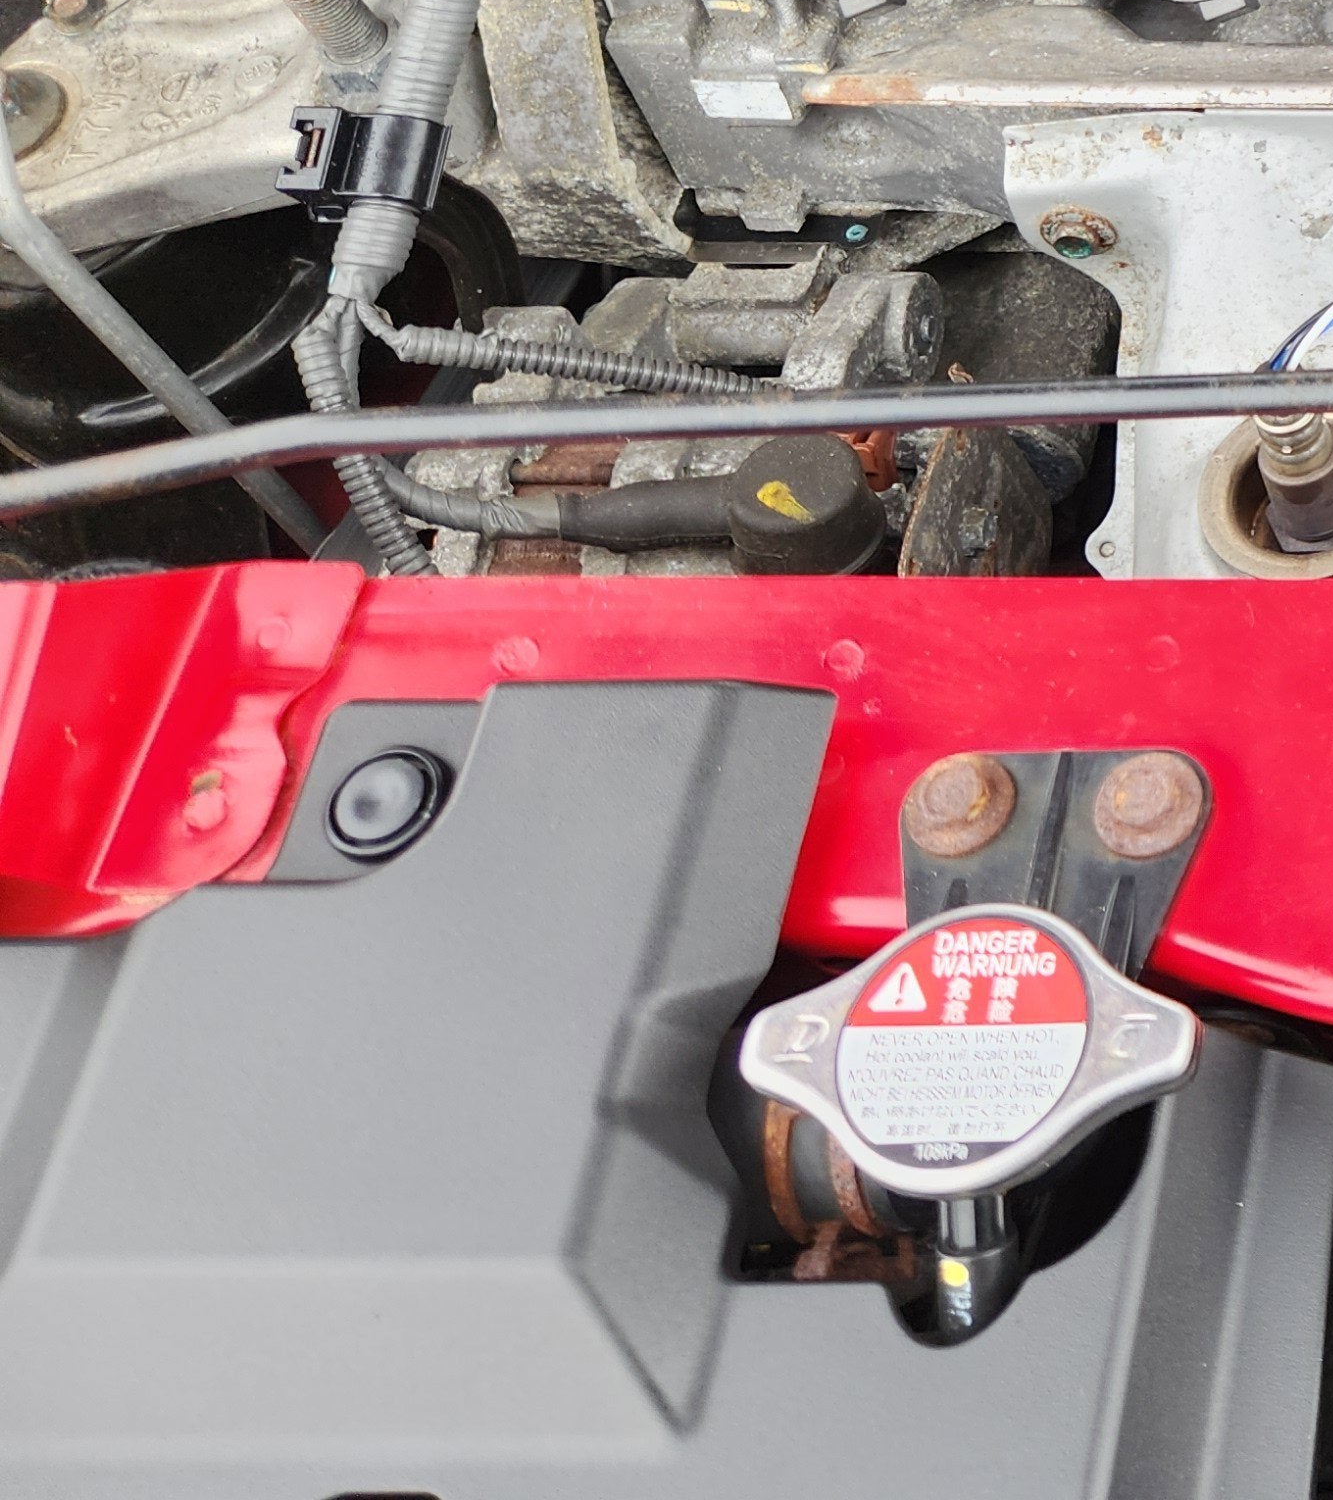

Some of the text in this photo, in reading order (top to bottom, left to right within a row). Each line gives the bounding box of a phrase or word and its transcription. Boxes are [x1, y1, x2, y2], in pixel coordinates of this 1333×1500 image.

[933, 929, 1038, 955] DANGER
[931, 952, 1057, 978] WARNUNG
[870, 1032, 923, 1047] NEVER
[927, 1031, 969, 1046] OPEN
[975, 1030, 1019, 1045] WHEN
[926, 1066, 958, 1082] PAS
[958, 1065, 1010, 1081] QUAND
